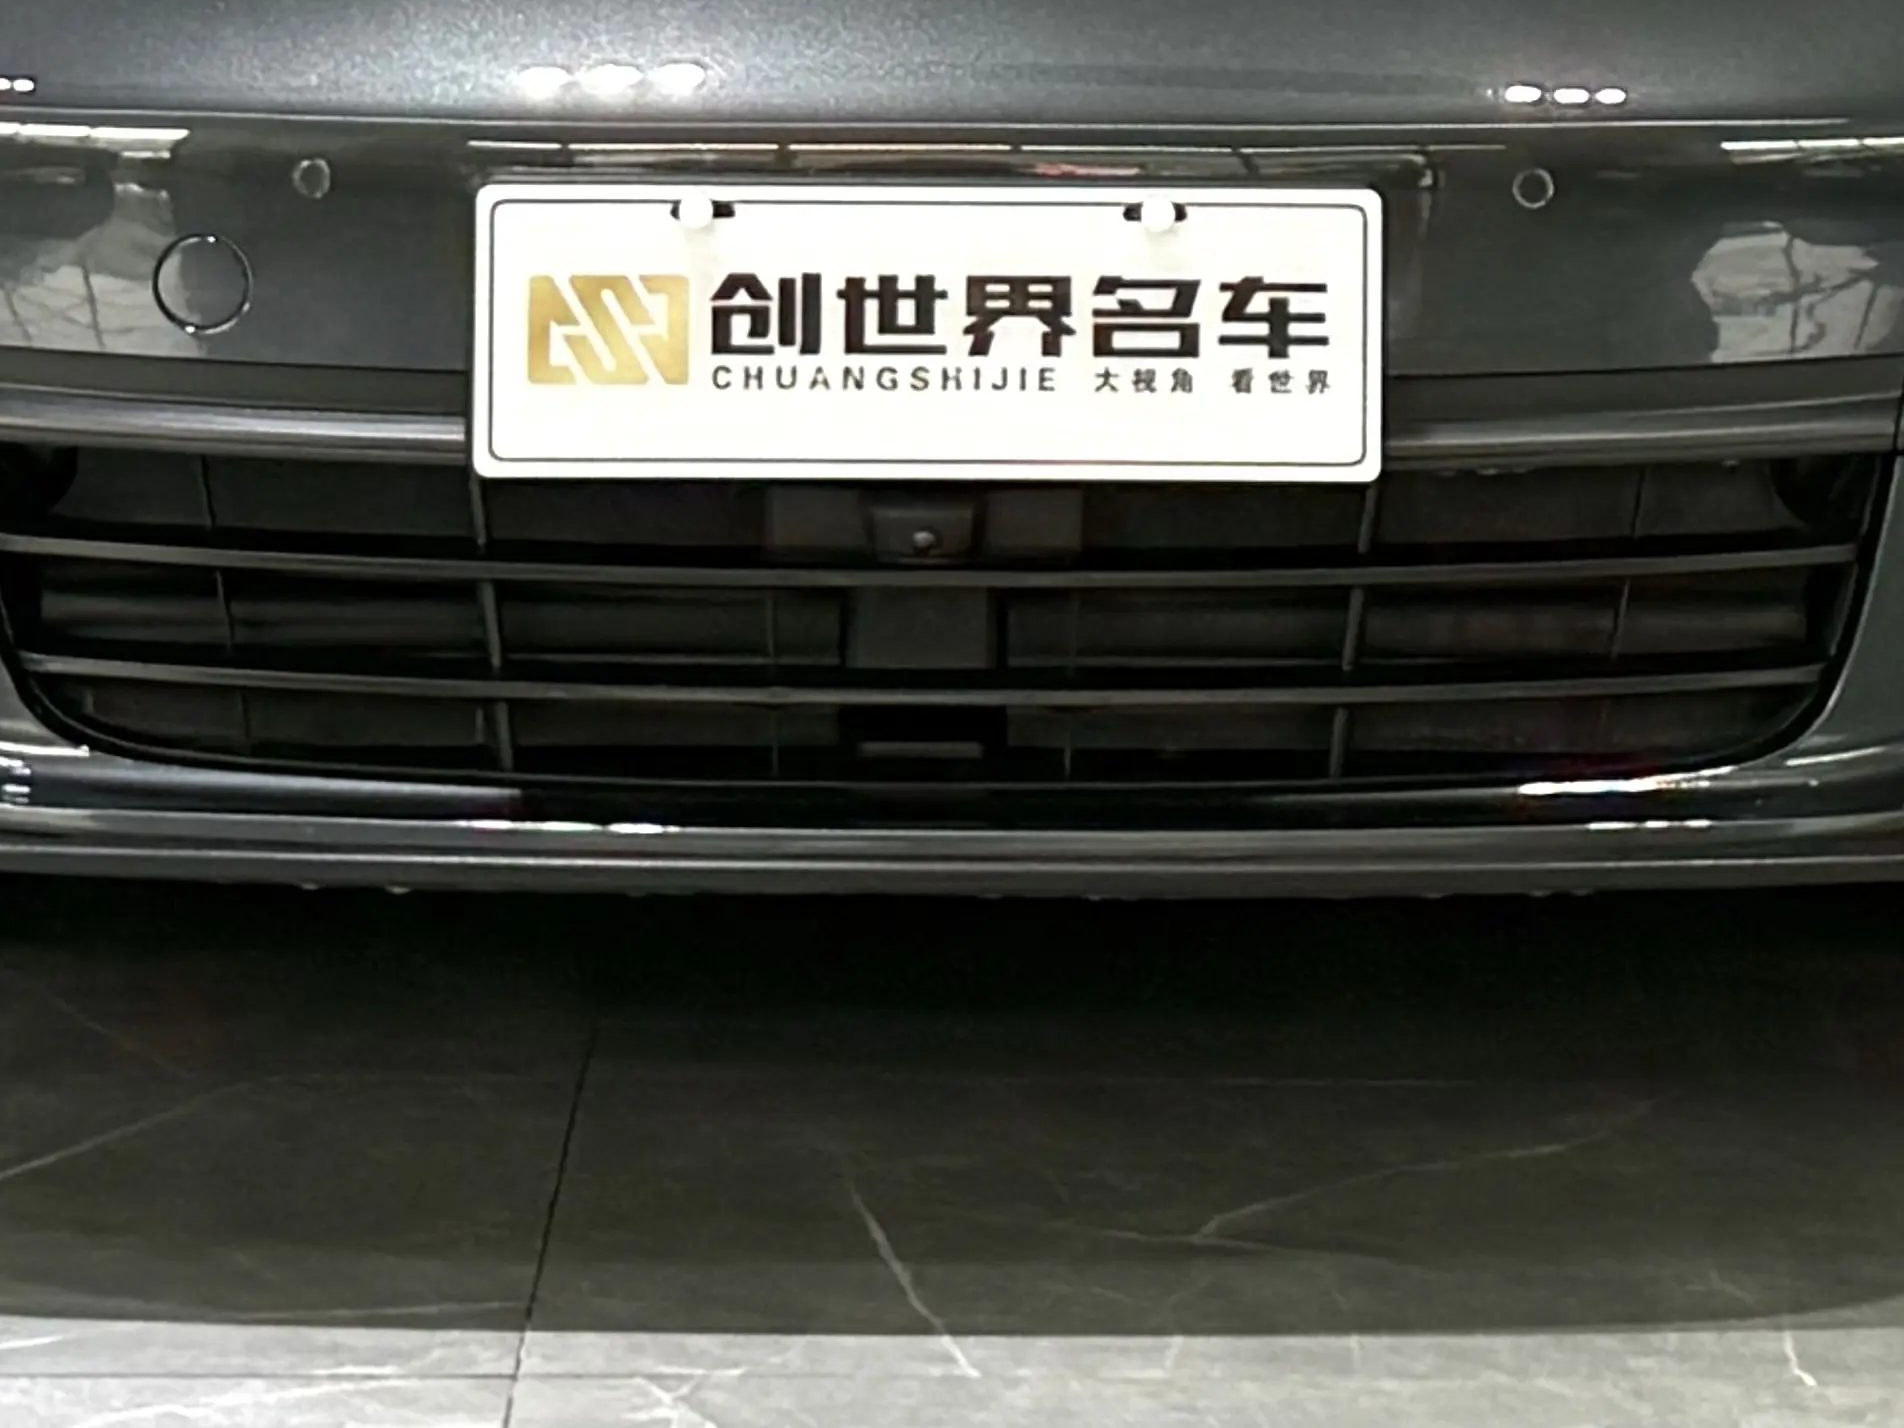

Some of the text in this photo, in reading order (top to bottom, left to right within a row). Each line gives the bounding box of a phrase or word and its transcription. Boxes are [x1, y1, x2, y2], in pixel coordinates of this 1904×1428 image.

[710, 272, 1330, 359] 创世界名车
[712, 365, 1056, 393] CHUANGSHIJIE
[1094, 366, 1332, 395] 大视角 看世界
